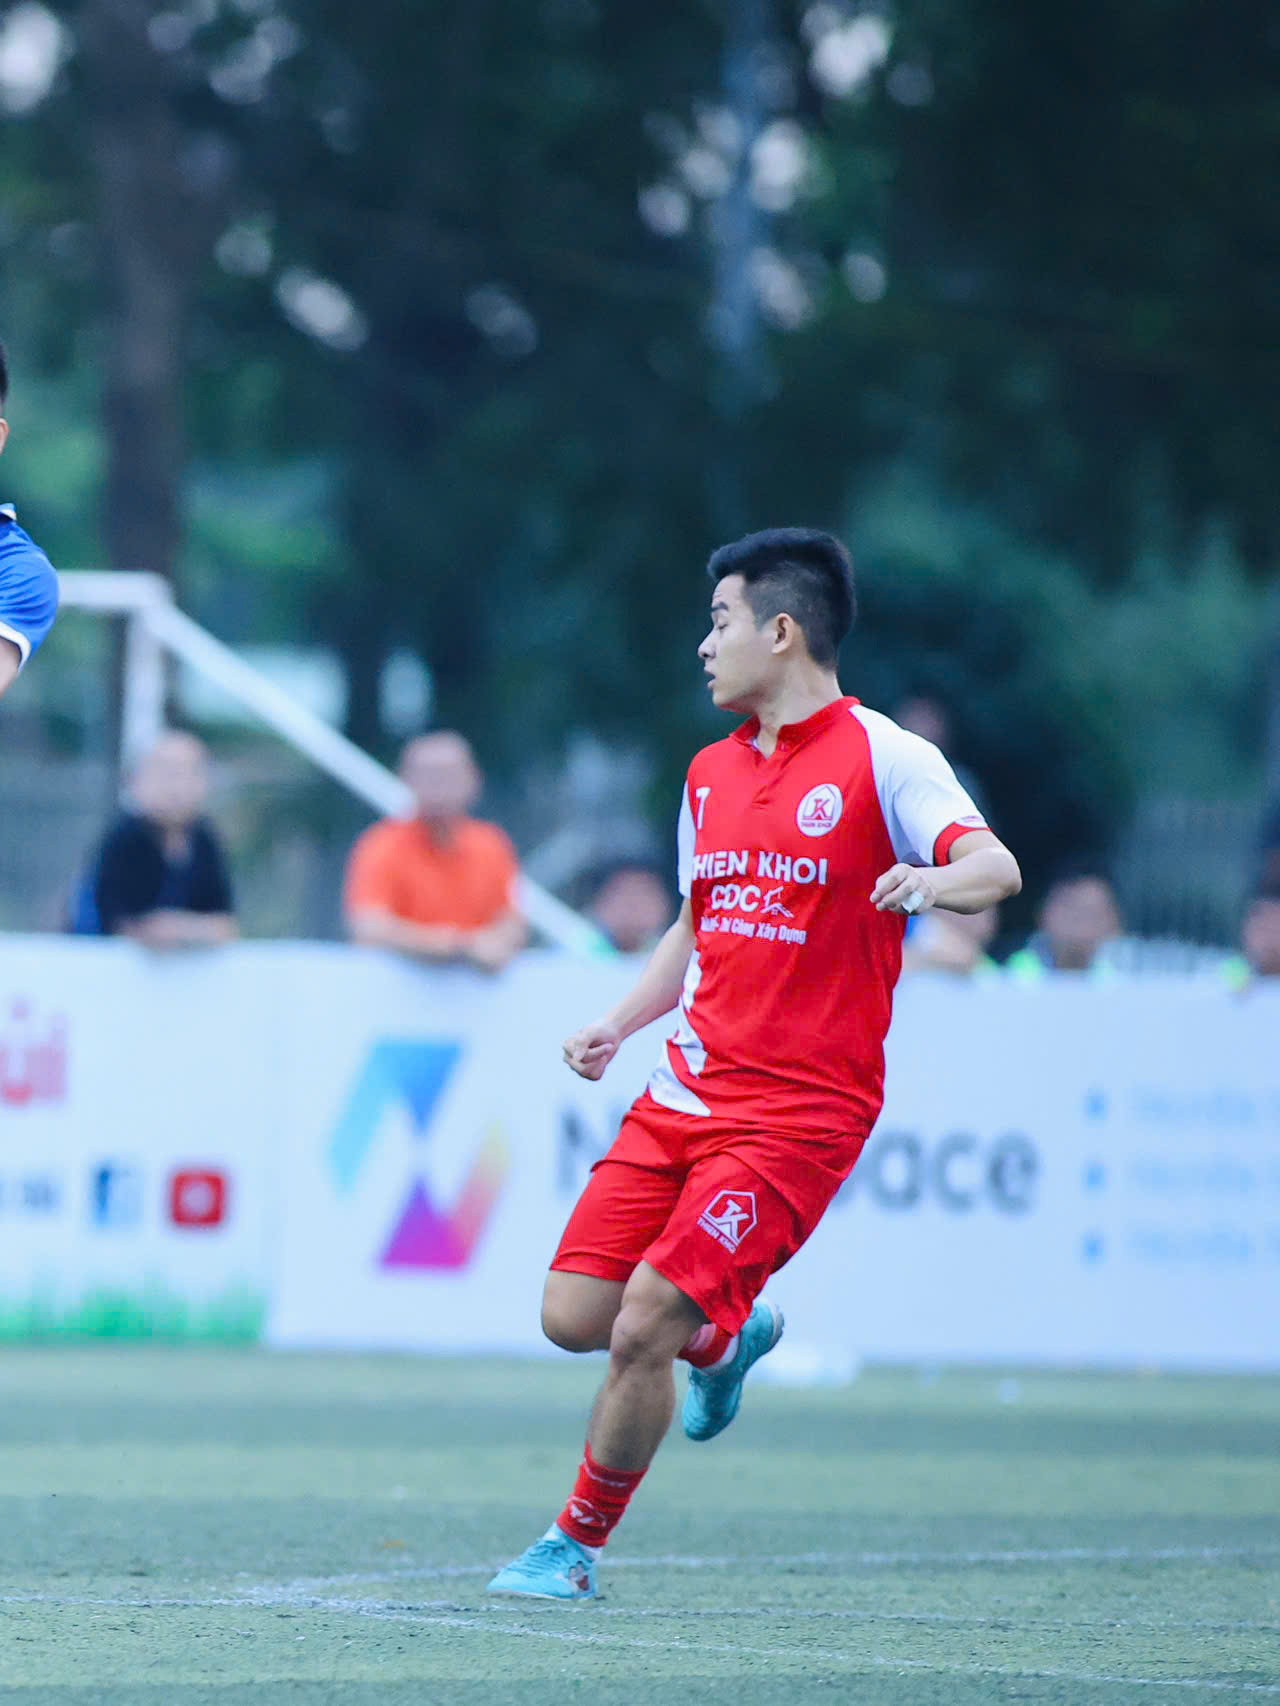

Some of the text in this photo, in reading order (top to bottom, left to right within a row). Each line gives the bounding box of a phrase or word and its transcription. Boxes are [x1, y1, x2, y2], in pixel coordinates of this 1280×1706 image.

[694, 786, 712, 831] 7
[692, 849, 829, 886] HIEN KHOI
[711, 883, 762, 913] CDC
